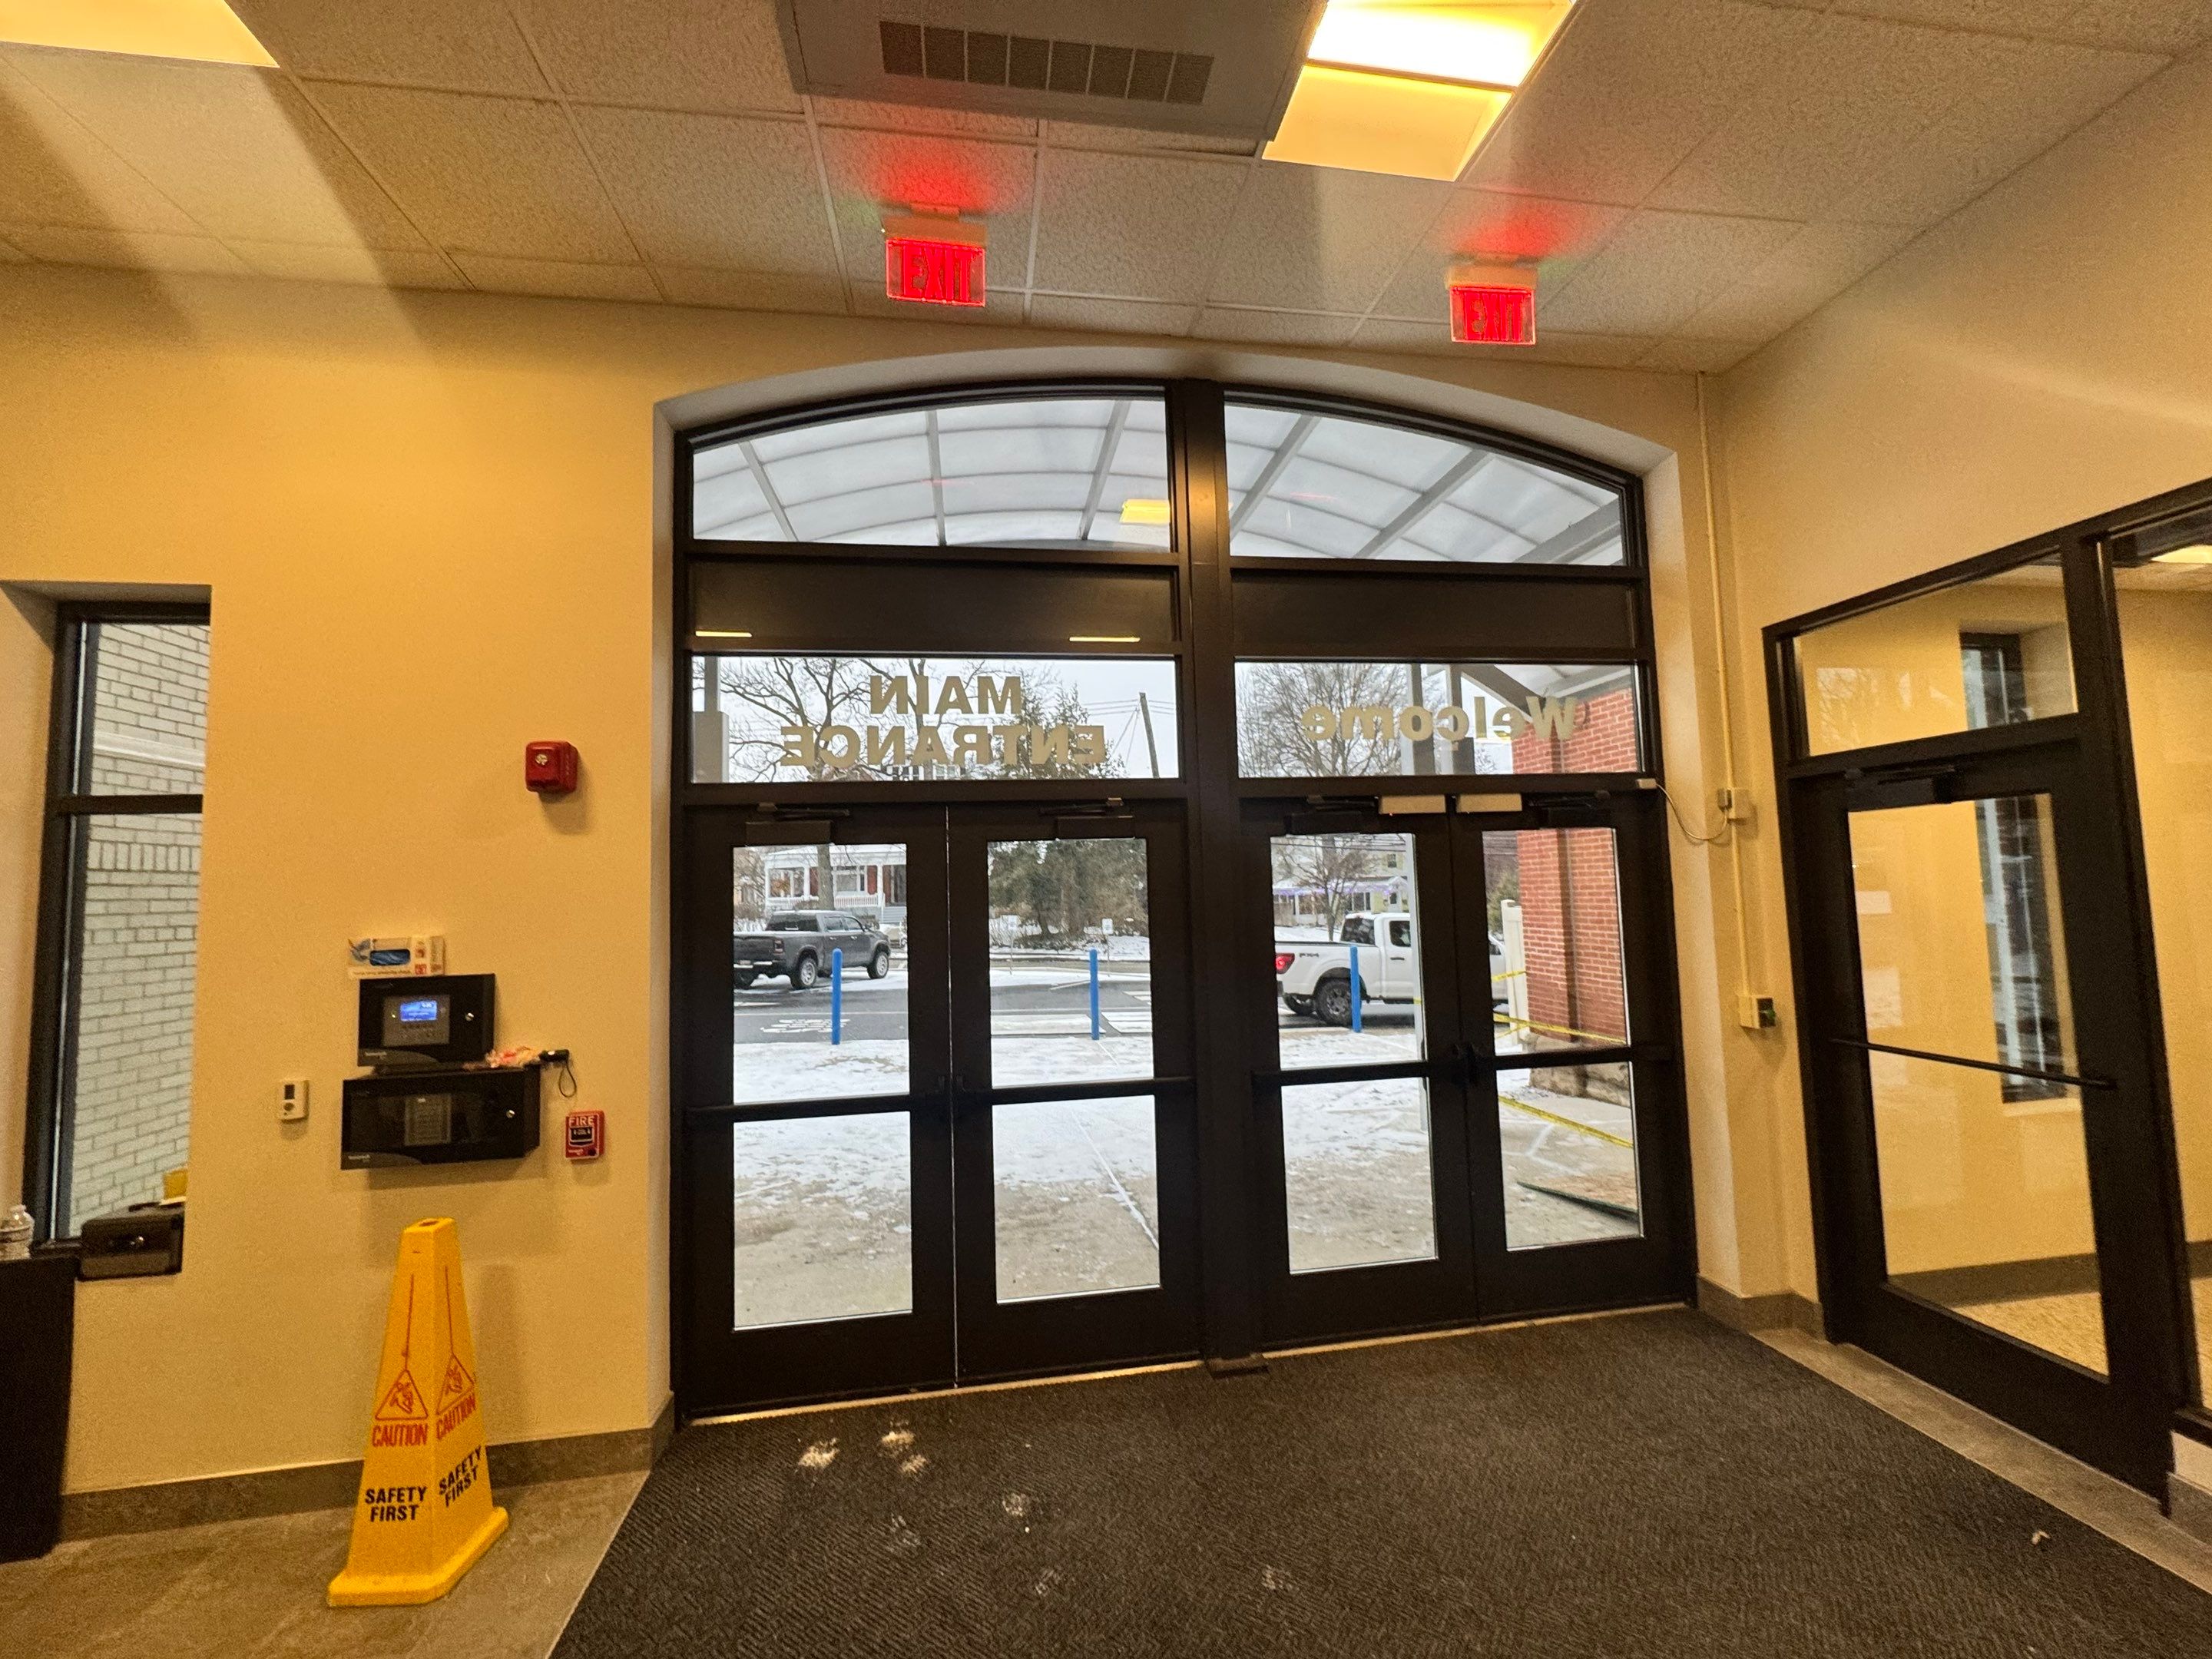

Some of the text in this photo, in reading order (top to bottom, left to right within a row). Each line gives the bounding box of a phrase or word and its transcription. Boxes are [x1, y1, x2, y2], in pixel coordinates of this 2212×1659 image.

[902, 244, 972, 302] EXIT
[1464, 292, 1523, 341] EXIT
[569, 1116, 594, 1127] FIRE
[373, 1424, 428, 1448] CAUTION
[436, 1396, 476, 1440] CAUTION
[439, 1446, 482, 1495] SAFETY
[445, 1465, 478, 1507] FIRST
[365, 1486, 427, 1504] SAFETY
[370, 1505, 419, 1522] FIRST
